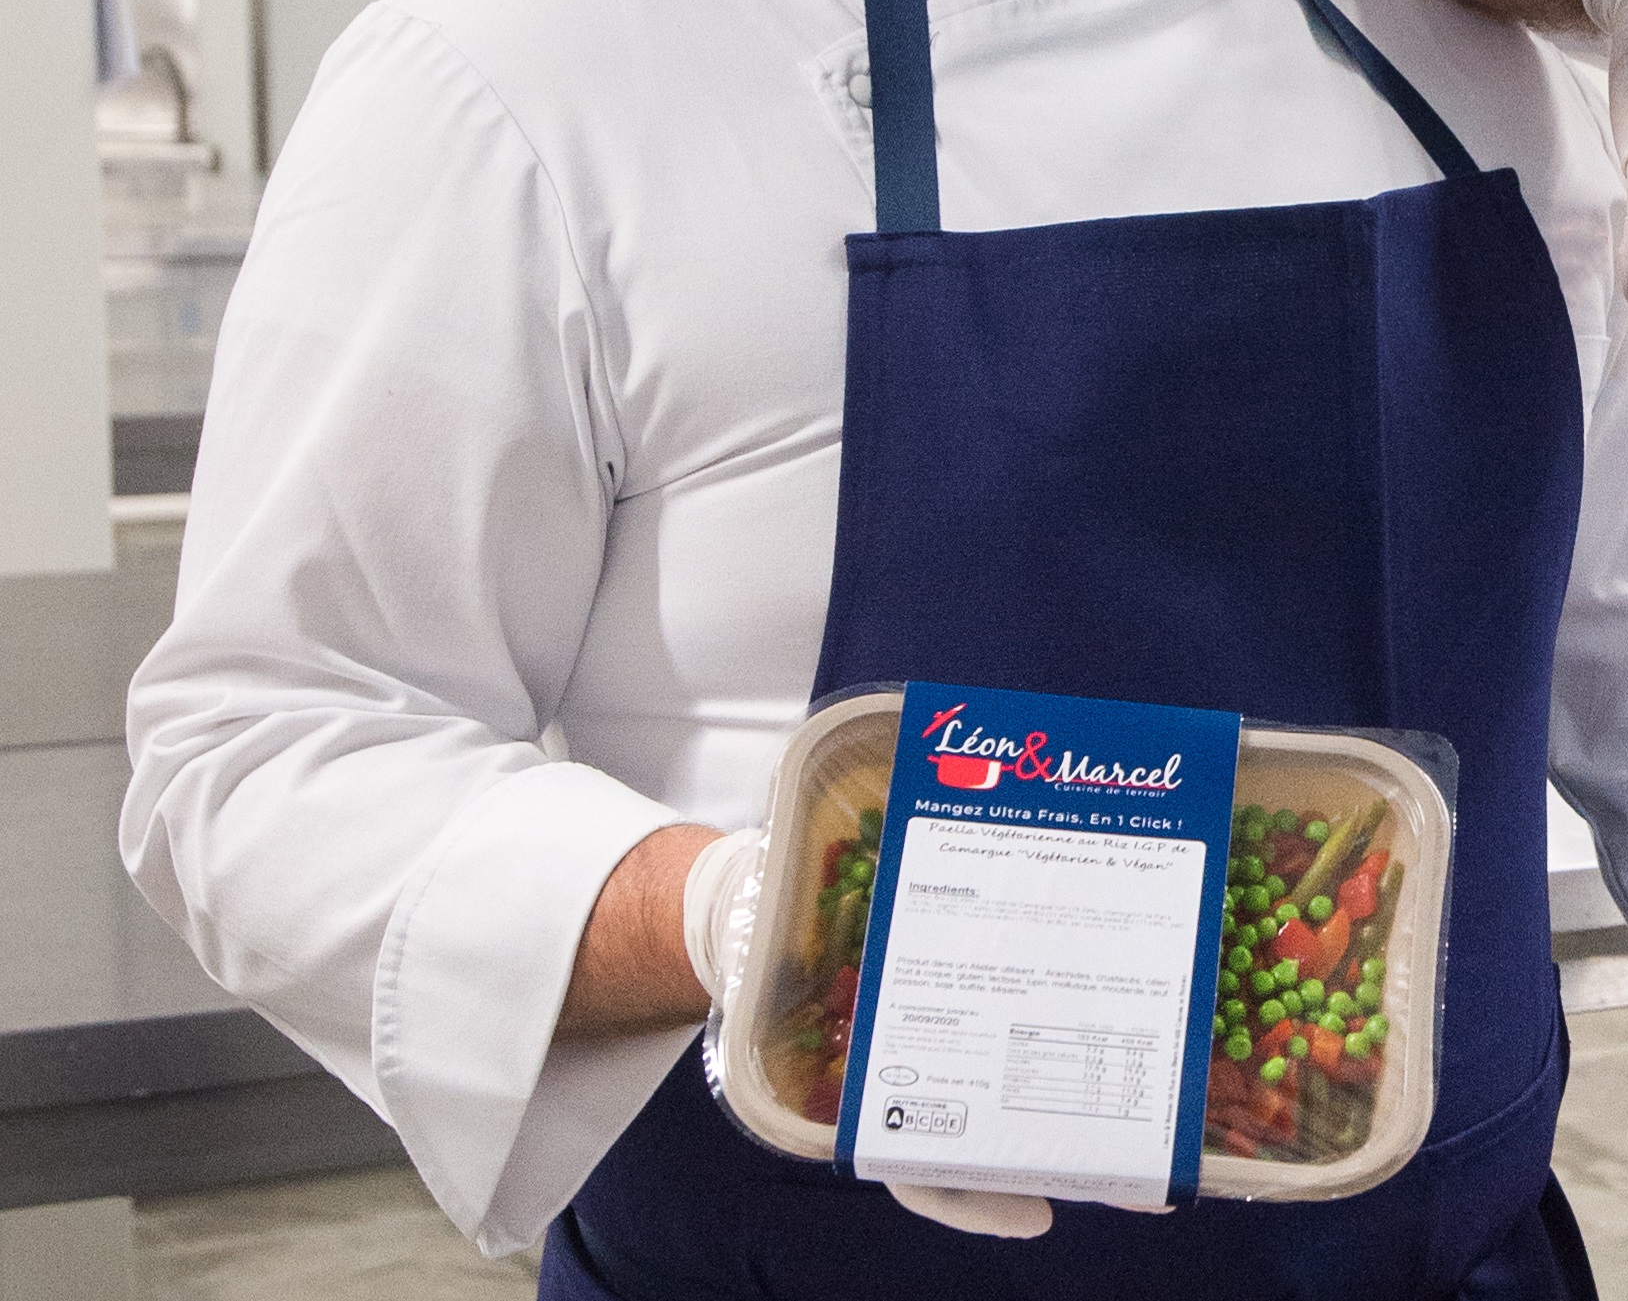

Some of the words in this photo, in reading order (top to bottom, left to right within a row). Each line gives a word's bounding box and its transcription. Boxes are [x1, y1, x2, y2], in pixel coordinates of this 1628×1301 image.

[934, 719, 1025, 757] Léon
[1014, 731, 1053, 780] &
[1044, 750, 1183, 790] Marcel
[1054, 783, 1101, 794] Cuisine
[1106, 786, 1120, 795] de
[1125, 788, 1167, 798] terroir
[914, 799, 983, 816] Mangez
[989, 805, 1031, 820] Ultra
[1090, 813, 1111, 826] En
[1117, 814, 1123, 826] 1
[1129, 816, 1172, 830] Click
[1177, 818, 1183, 830] !
[929, 821, 978, 835] Paella
[981, 827, 1075, 844] Végétarienne
[1078, 838, 1099, 846] au
[1103, 837, 1128, 850] Riz
[1171, 843, 1191, 854] de
[939, 842, 1013, 859] Camargue
[887, 1110, 902, 1126] A
[905, 1115, 914, 1125] B
[919, 1115, 929, 1126] C
[934, 1117, 944, 1128] D
[950, 1119, 958, 1129] E
